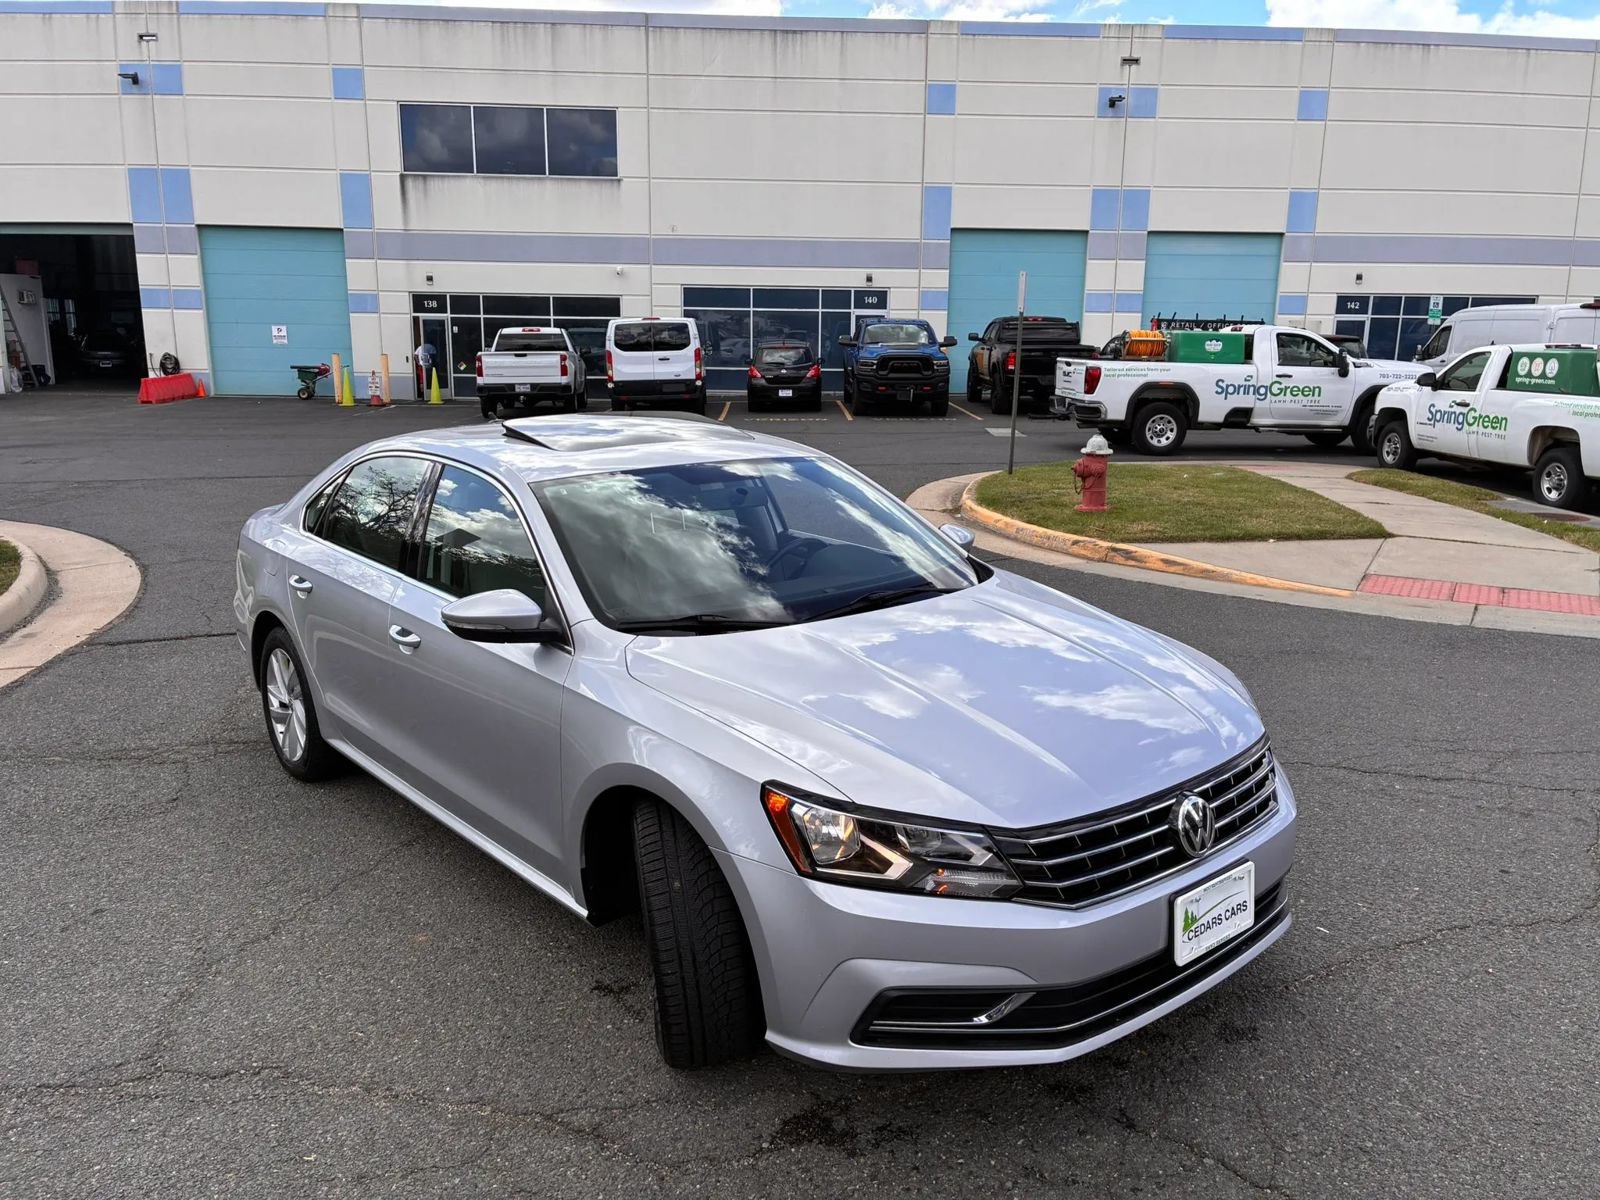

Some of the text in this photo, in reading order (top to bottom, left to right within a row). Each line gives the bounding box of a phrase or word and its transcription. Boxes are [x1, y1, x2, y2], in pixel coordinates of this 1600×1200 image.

[424, 300, 438, 308] 138
[863, 296, 878, 304] 140
[1346, 301, 1360, 309] 142
[1515, 377, 1556, 385] spring-green.com
[1215, 377, 1322, 401] SpringGreen
[1427, 403, 1508, 431] SpringGreen
[1187, 900, 1249, 942] CEDARS CARS
